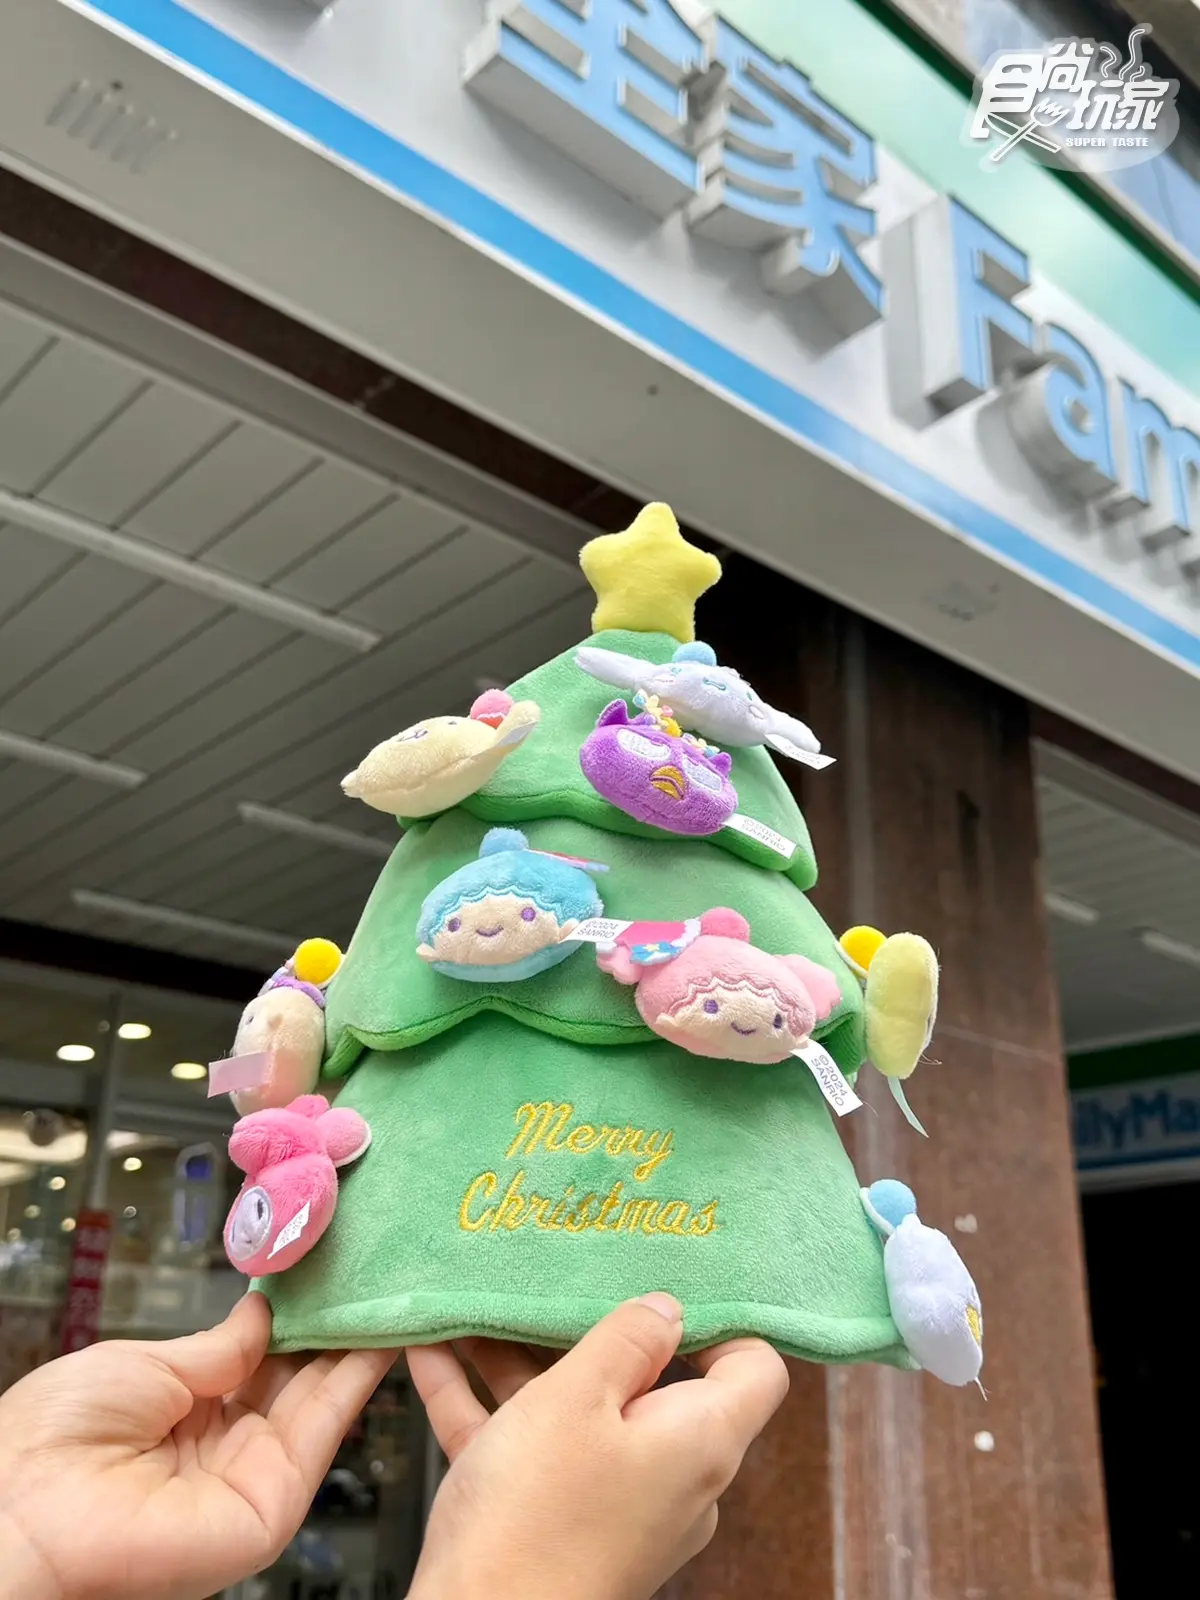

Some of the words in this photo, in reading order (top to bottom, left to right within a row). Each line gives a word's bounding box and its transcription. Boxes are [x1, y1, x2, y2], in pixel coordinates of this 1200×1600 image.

[811, 1058, 845, 1107] SANRIO
[505, 1100, 675, 1183] Merry
[458, 1168, 720, 1236] Christmas
